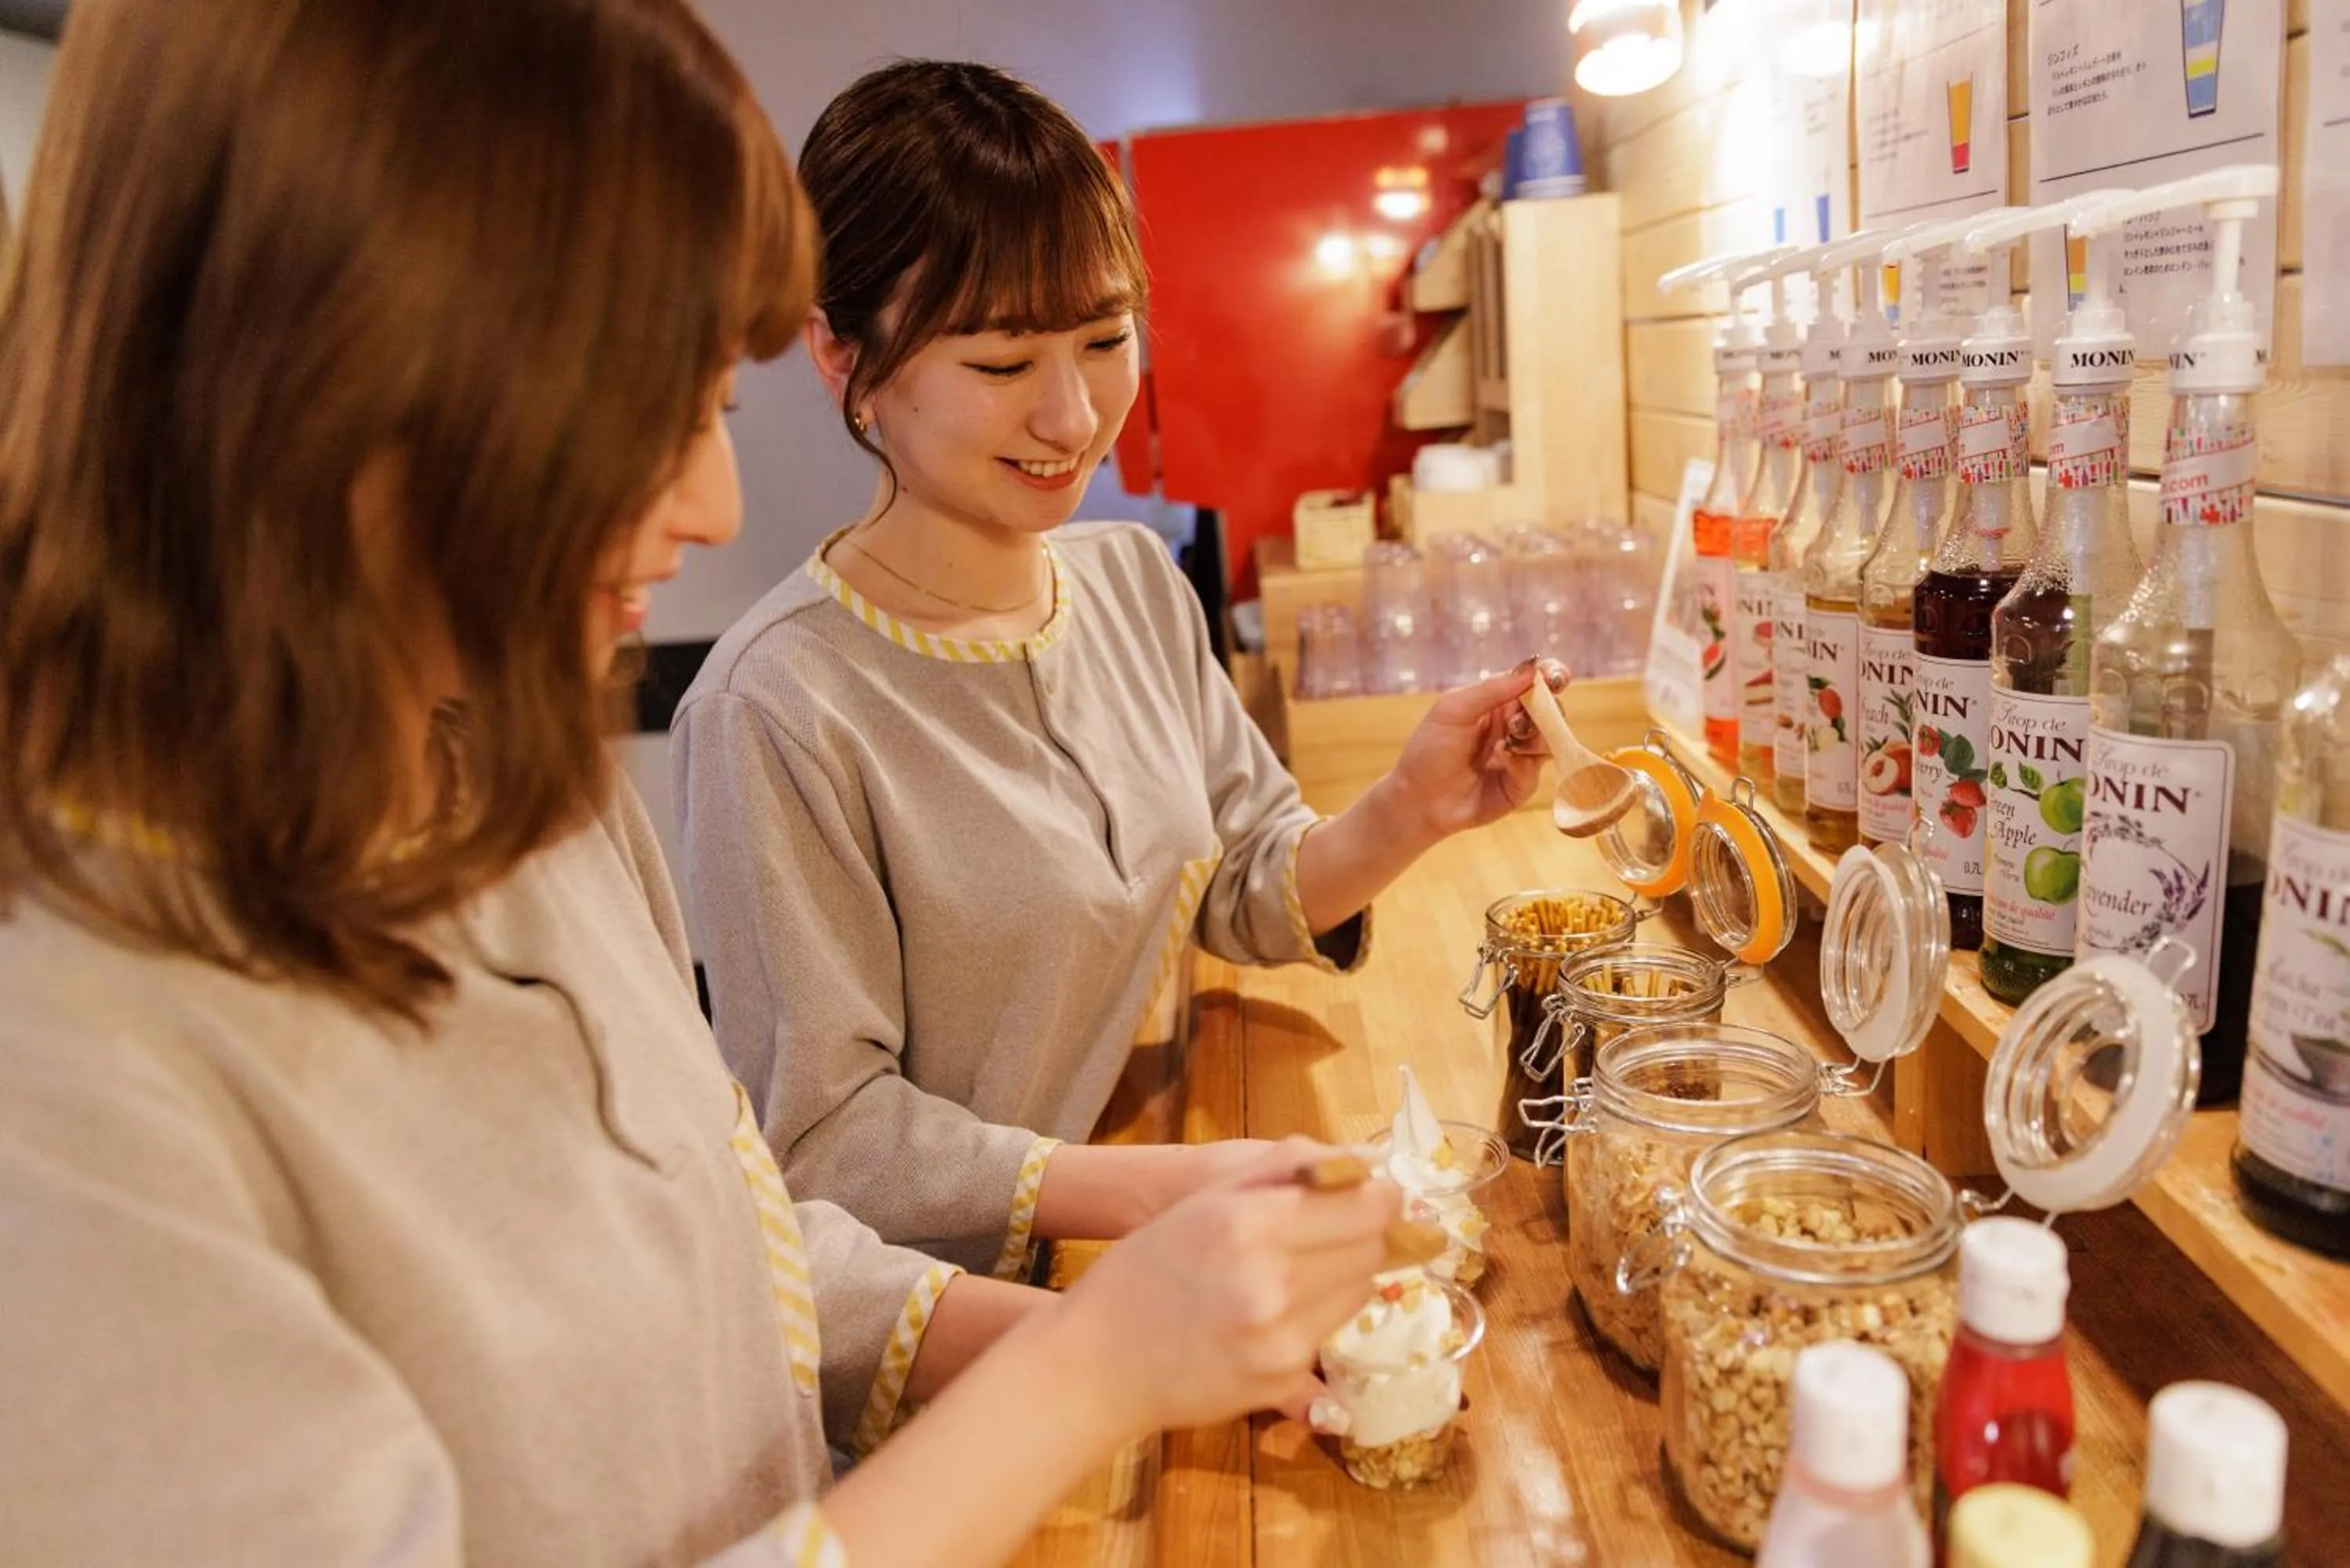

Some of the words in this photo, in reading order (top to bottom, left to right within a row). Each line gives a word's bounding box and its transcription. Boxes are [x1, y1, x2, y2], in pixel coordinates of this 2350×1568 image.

[1868, 350, 1899, 363] MON
[1915, 688, 1970, 720] NIN
[1990, 724, 2086, 764] ONIN
[2089, 770, 2192, 815] NIN
[1990, 818, 2037, 848] Apple
